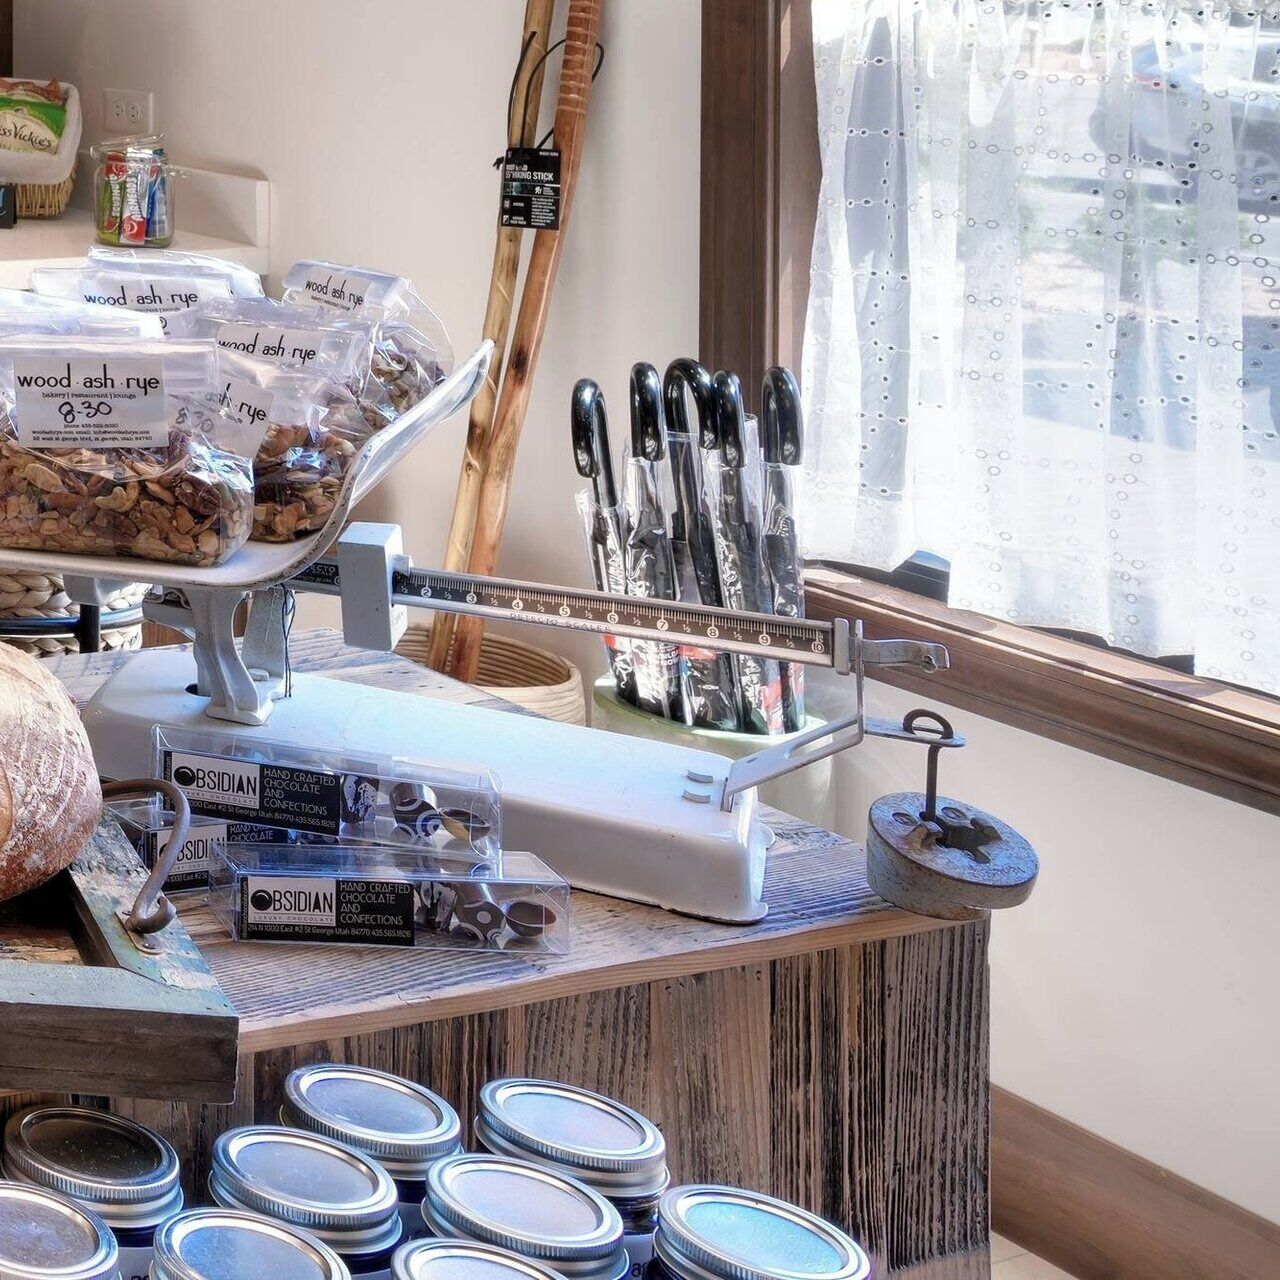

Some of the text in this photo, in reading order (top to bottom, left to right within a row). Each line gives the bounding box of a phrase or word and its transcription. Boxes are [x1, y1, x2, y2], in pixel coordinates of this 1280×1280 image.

[13, 120, 53, 150] Vickie's
[533, 171, 554, 181] STICK
[109, 174, 121, 217] AIRHEADS
[126, 177, 144, 221] AIRHEADS
[84, 284, 199, 308] wood ash rye
[304, 275, 333, 296] wood
[330, 279, 346, 300] ash
[348, 291, 364, 310] rye
[262, 334, 285, 357] ash
[291, 347, 316, 365] rye
[17, 363, 160, 396] wood ash rye
[42, 391, 67, 399] bakery
[113, 392, 137, 400] lounge
[239, 402, 267, 425] rye
[173, 766, 257, 797] OBSIDIAN
[263, 768, 336, 787] HAND CRAFTED
[263, 777, 321, 795] CHOCOLATE
[264, 787, 285, 799] AND
[235, 806, 258, 817] George
[258, 809, 274, 819] Utah
[263, 797, 328, 816] CONFECTIONS
[340, 882, 411, 894] HAND CRAFTED
[250, 889, 333, 914] OBSIDIAN
[340, 893, 396, 905] CHOCOLATE
[340, 903, 361, 913] AND
[340, 913, 404, 926] CONFECTIONS
[280, 925, 294, 933] East
[312, 926, 335, 936] George
[335, 927, 350, 936] Utah
